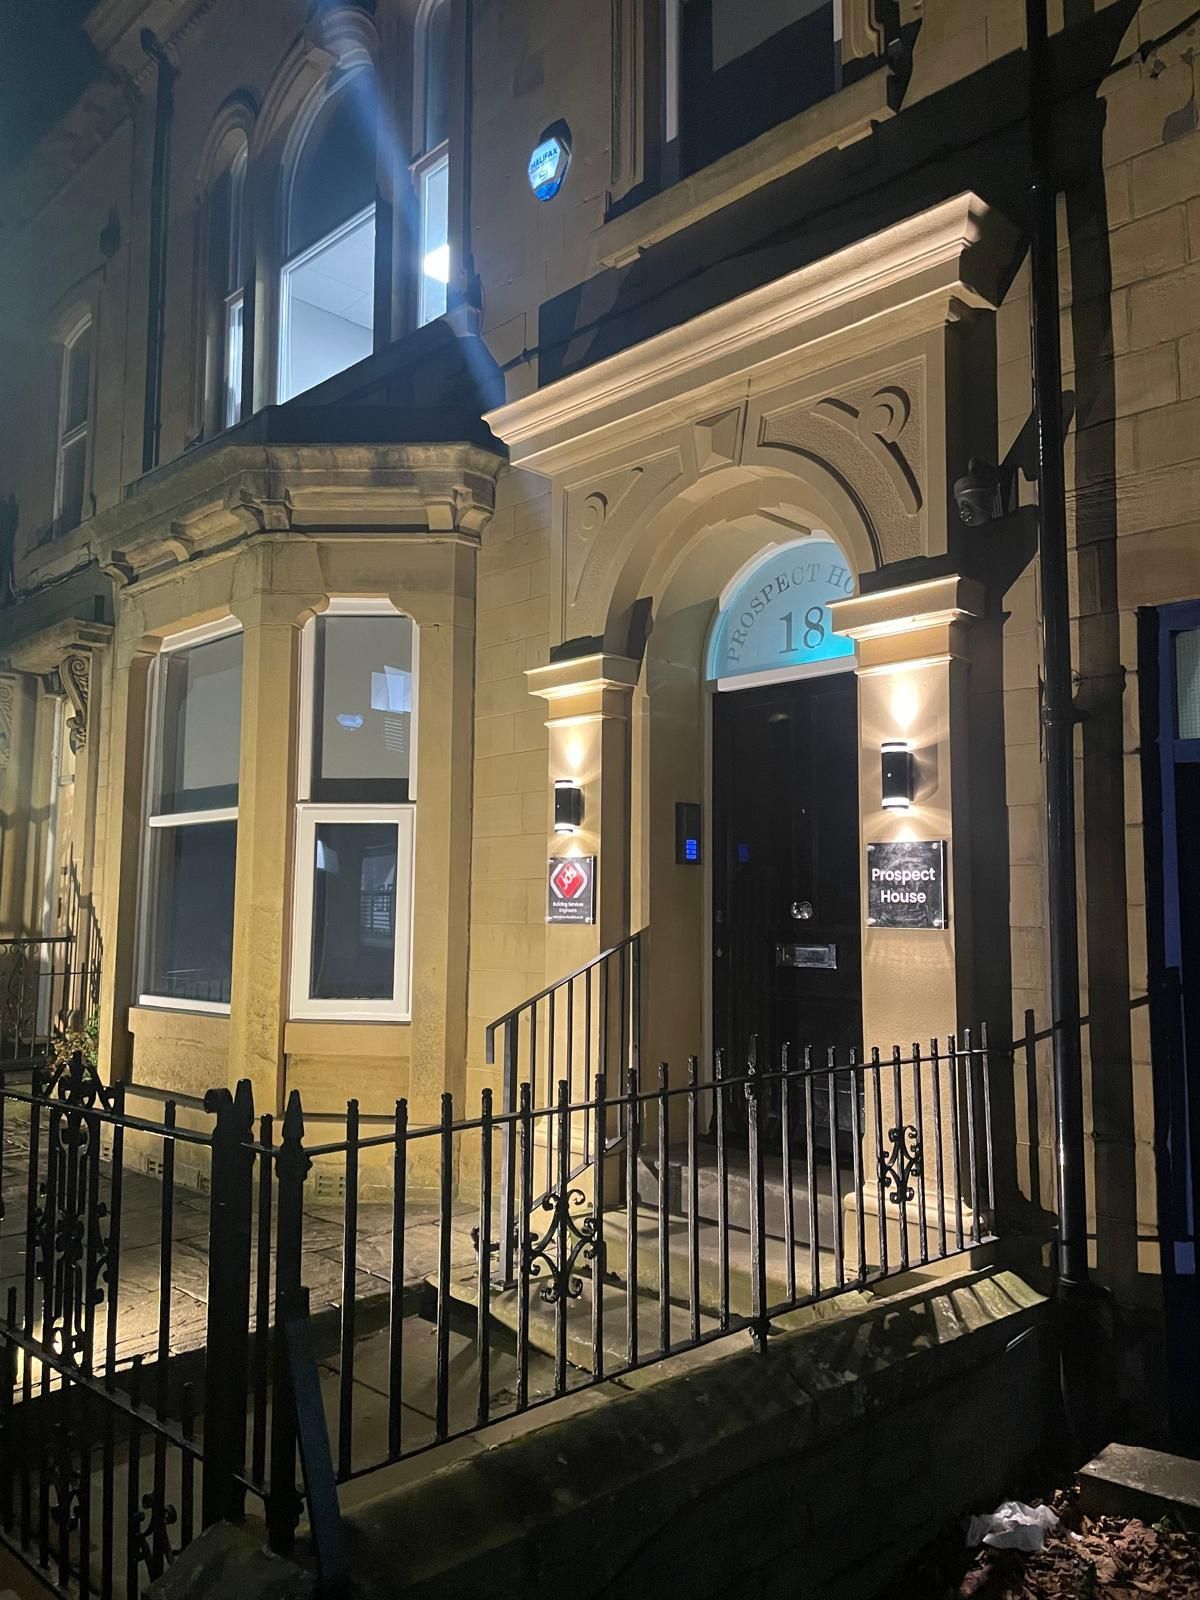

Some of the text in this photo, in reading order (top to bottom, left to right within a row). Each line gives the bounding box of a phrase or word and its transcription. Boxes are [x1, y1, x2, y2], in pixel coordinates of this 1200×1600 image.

[531, 147, 558, 169] HALIFAX
[726, 563, 820, 664] PROSPECT
[777, 606, 825, 654] 18
[871, 867, 936, 886] Prospect
[880, 889, 927, 903] House
